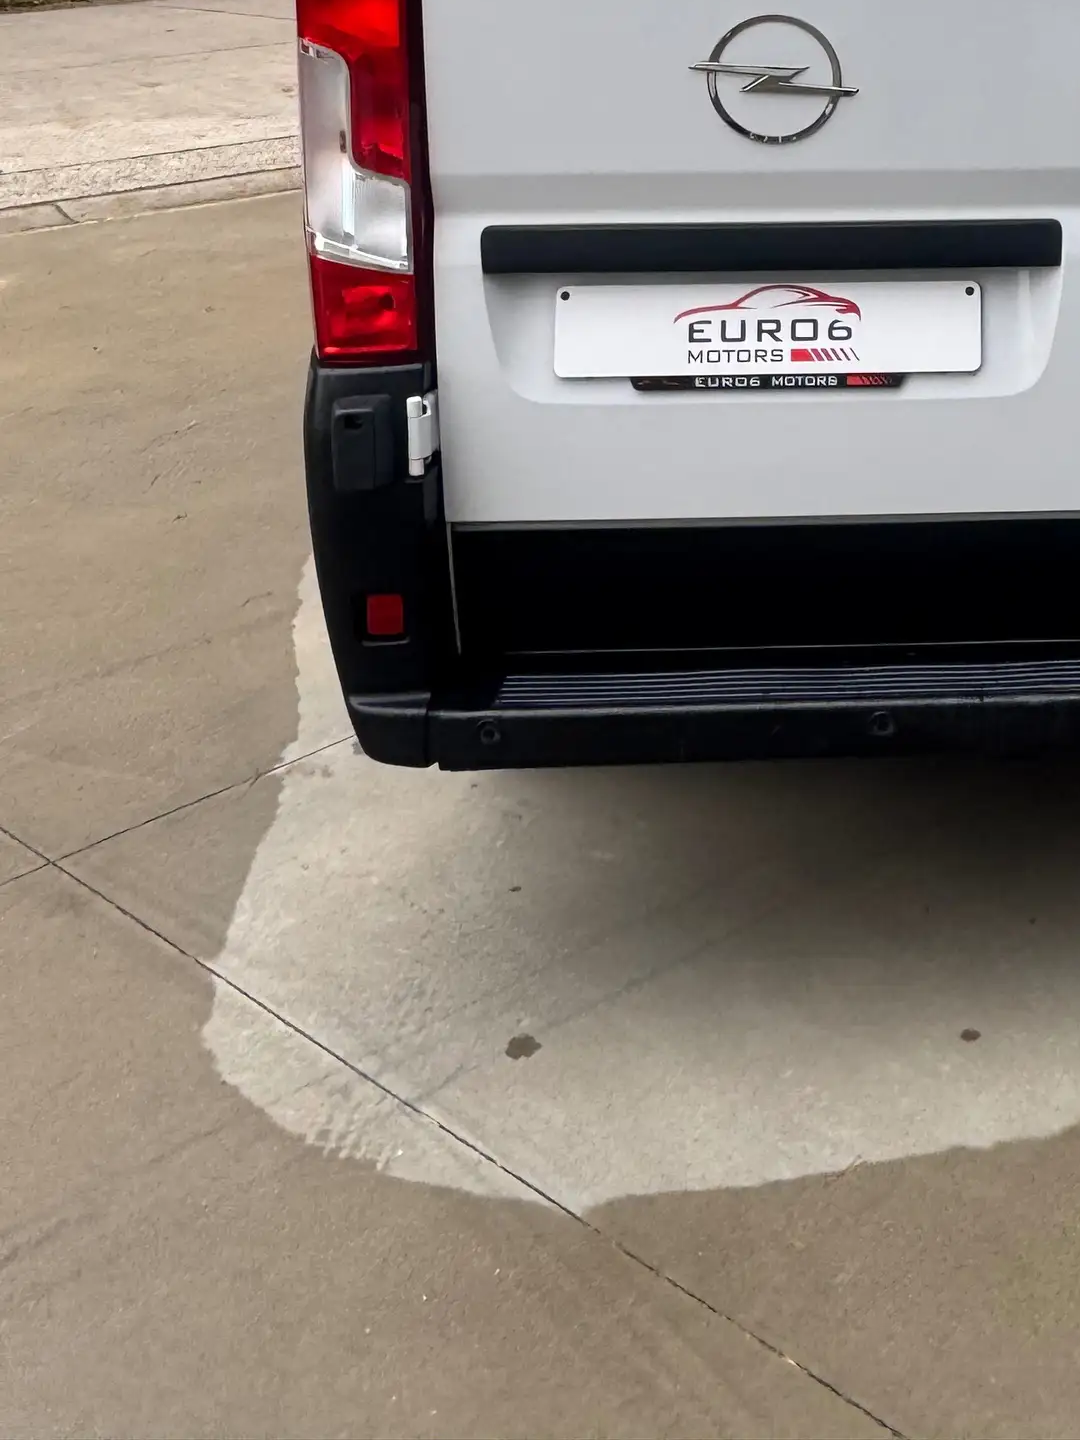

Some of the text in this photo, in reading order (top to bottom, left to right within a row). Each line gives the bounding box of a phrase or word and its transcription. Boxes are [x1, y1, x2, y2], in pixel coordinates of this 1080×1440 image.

[688, 319, 852, 342] EURO6
[688, 349, 783, 364] MOTORS
[694, 375, 838, 387] EURO6 MOTORS
